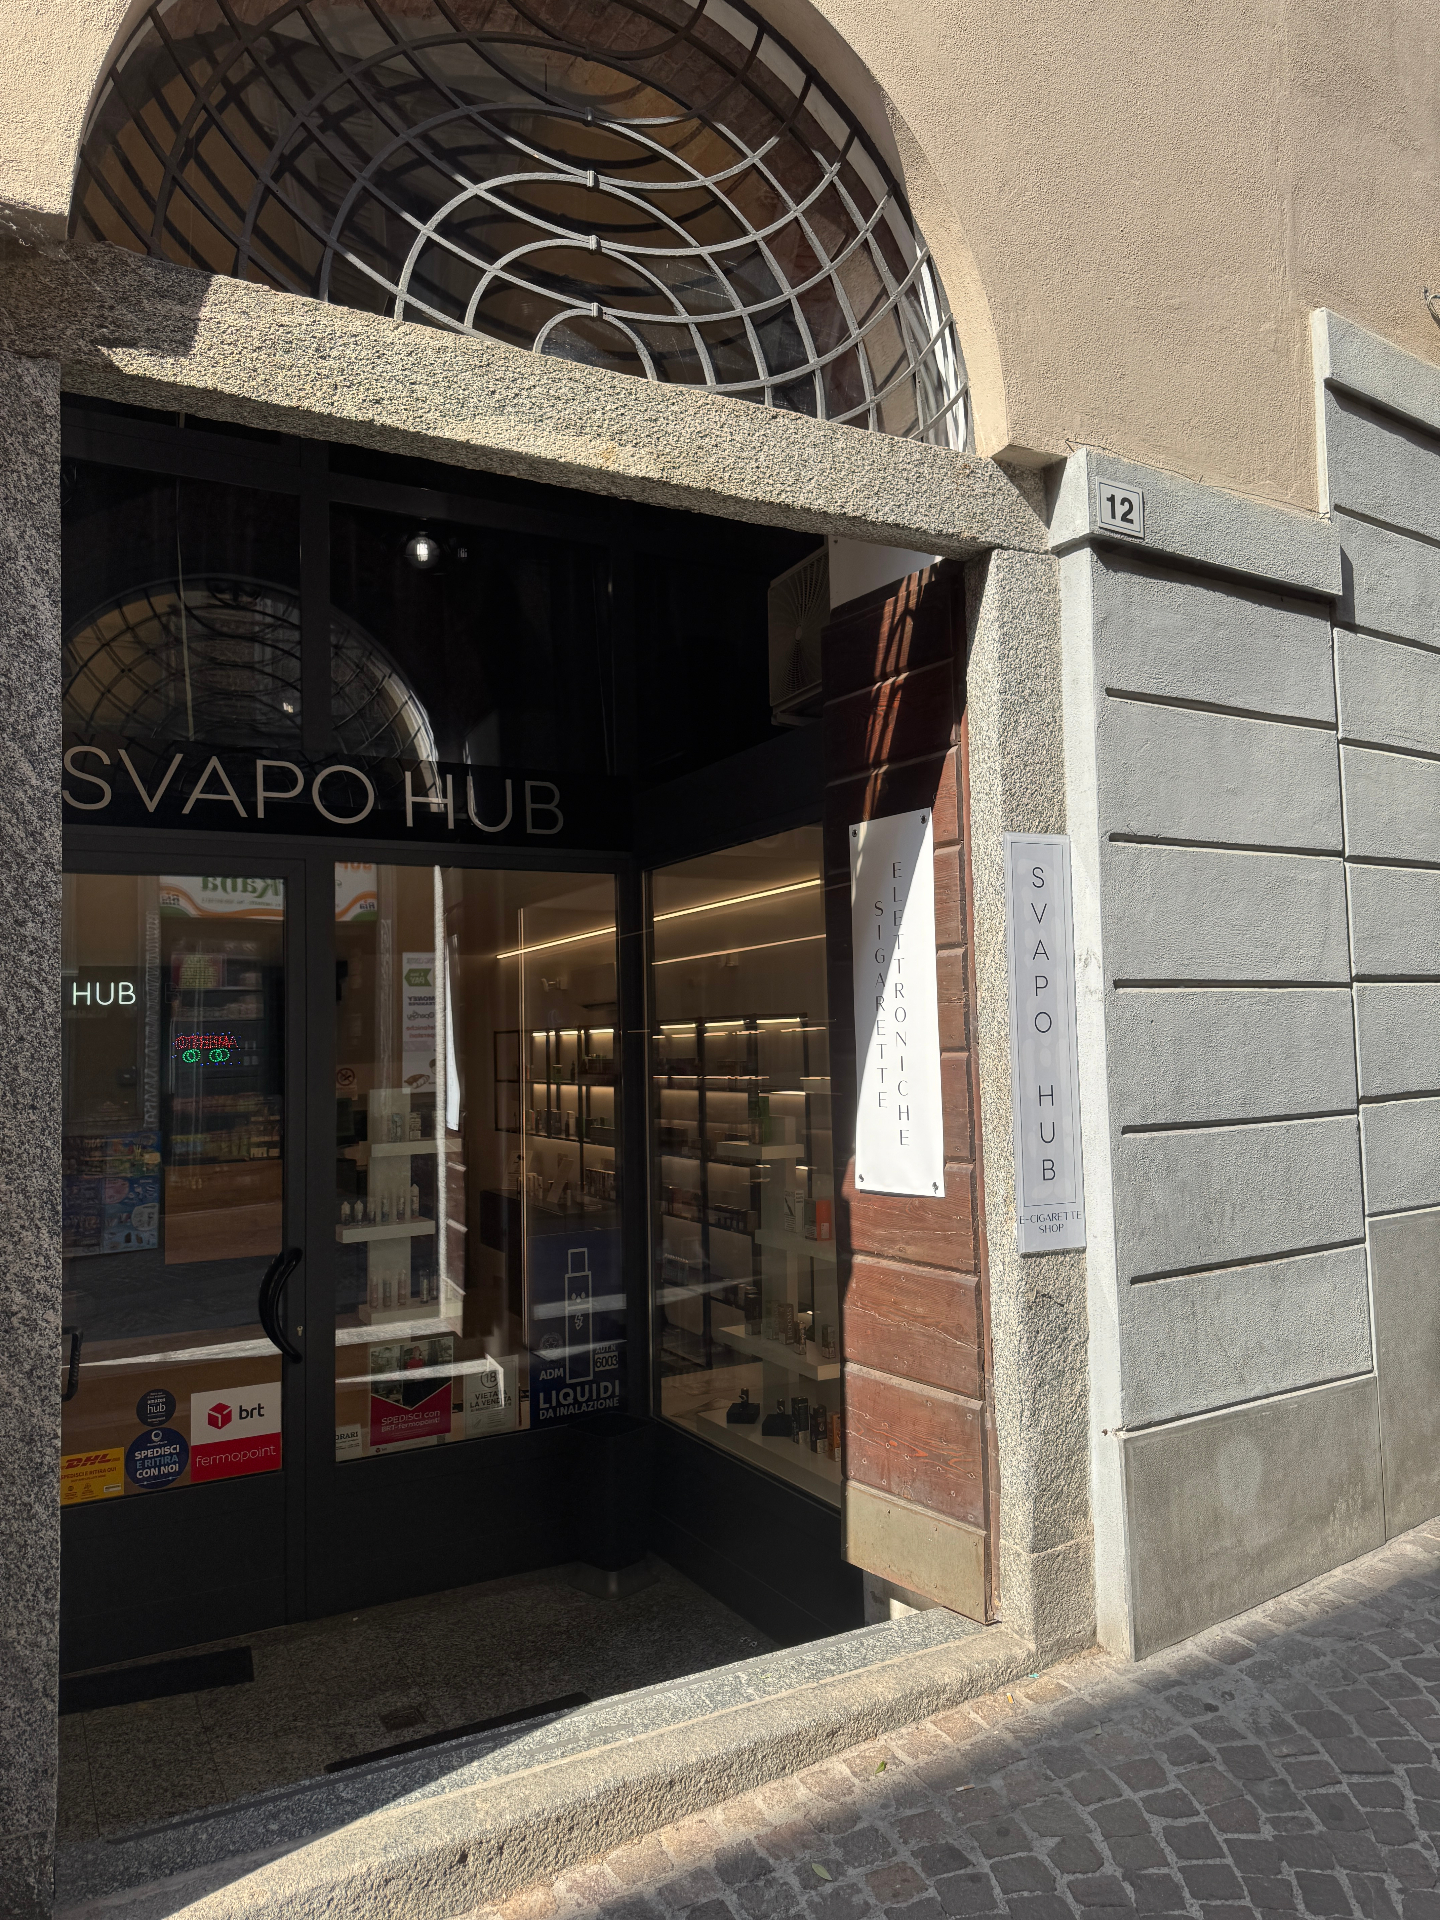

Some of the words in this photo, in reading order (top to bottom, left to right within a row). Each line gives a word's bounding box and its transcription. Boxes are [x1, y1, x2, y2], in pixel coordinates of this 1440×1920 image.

[1106, 493, 1134, 524] 12
[62, 745, 374, 825] SVAPO
[404, 771, 564, 835] HUB
[1031, 866, 1052, 1033] SVAPO
[72, 981, 136, 1006] HUB
[874, 900, 888, 1109] SIGARETTE
[892, 861, 910, 1146] ELETTRONICHE
[1038, 1084, 1056, 1181] HUB
[1019, 1210, 1082, 1225] E-CIGARETTE
[1038, 1223, 1064, 1234] SHOP
[595, 1355, 618, 1368] 6003
[484, 1371, 497, 1383] 18
[539, 1367, 563, 1381] ADM
[475, 1389, 507, 1400] VIETAA
[539, 1379, 620, 1409] LIQUIDI
[147, 1402, 166, 1414] hub
[239, 1403, 264, 1420] brt
[539, 1408, 554, 1420] DA
[556, 1396, 620, 1417] INALAZIONE
[381, 1411, 422, 1425] SPEDISCI
[424, 1410, 440, 1418] con
[134, 1444, 180, 1460] SPEDISCI
[196, 1445, 276, 1467] fermopoint
[65, 1453, 112, 1469] DHL
[136, 1460, 143, 1469] E
[144, 1454, 179, 1468] RITIRA
[136, 1467, 158, 1479] CON
[160, 1463, 179, 1475] NOI
